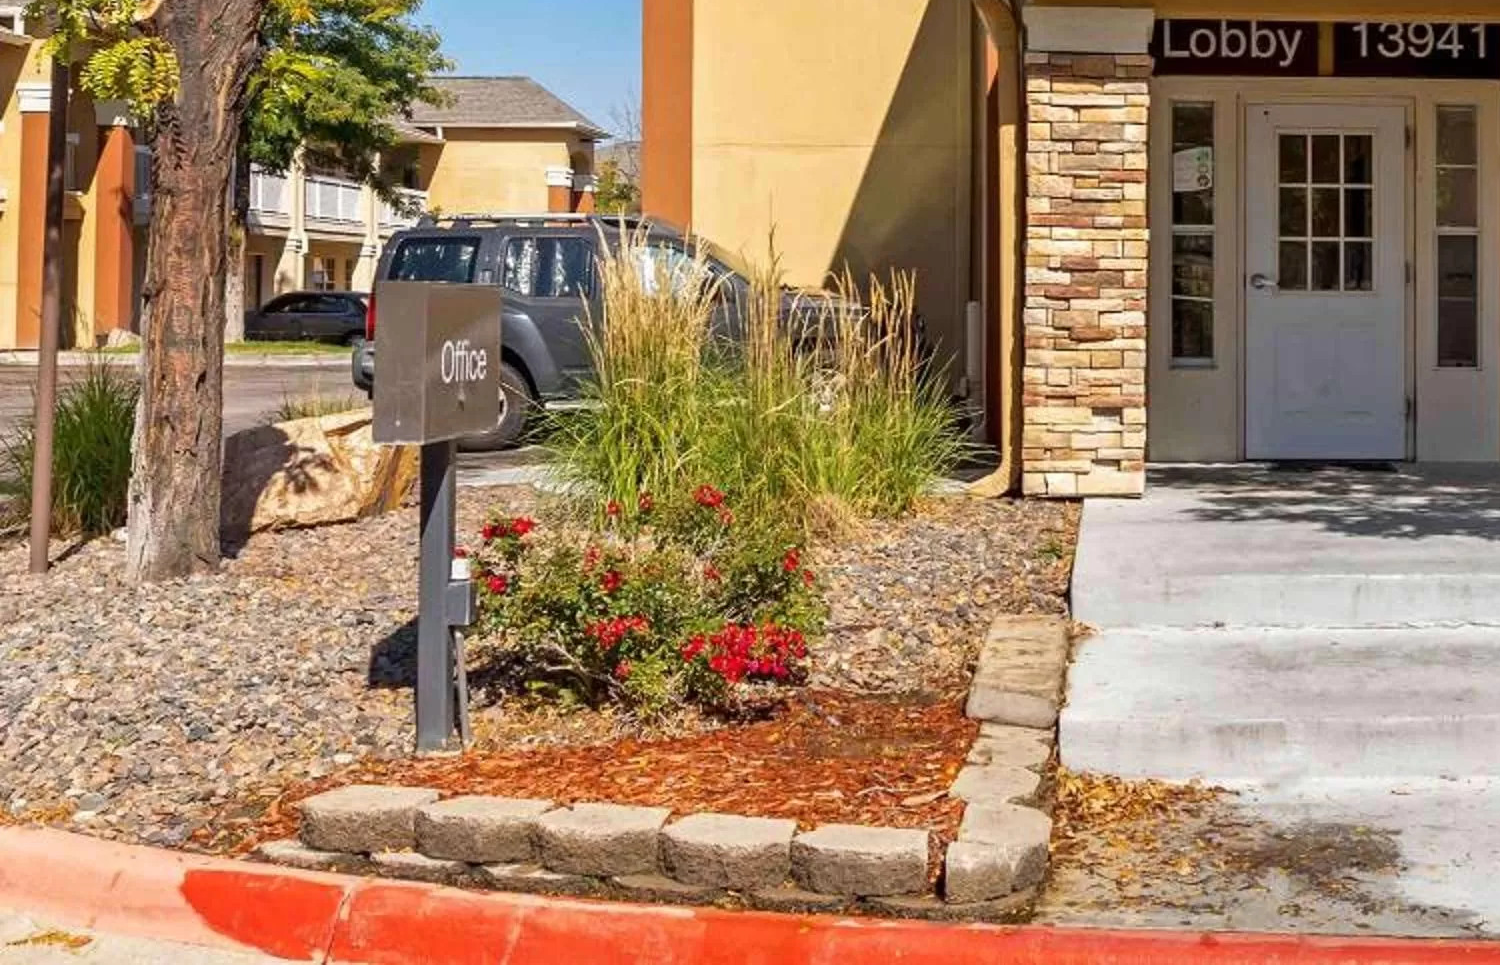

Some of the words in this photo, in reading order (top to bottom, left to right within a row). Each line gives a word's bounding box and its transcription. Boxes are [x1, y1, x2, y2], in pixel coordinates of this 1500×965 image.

[1163, 20, 1302, 67] Lobby
[1352, 22, 1488, 59] 13941
[441, 339, 487, 384] Office
